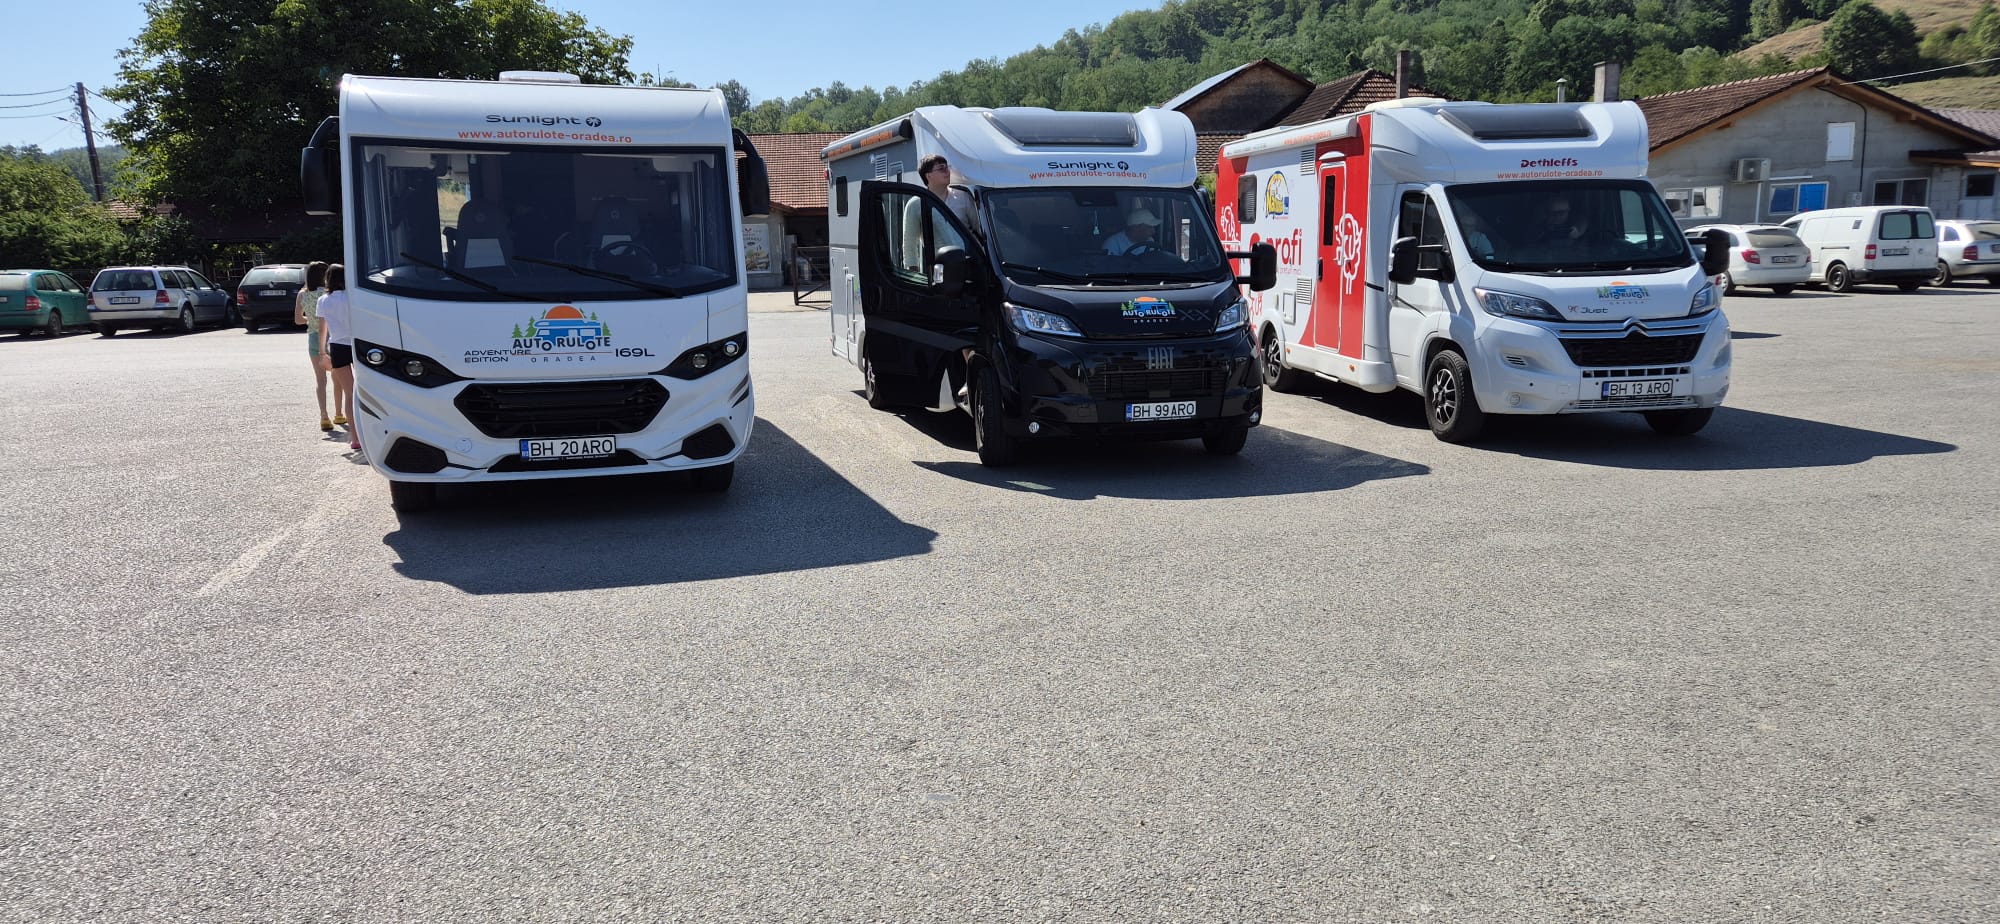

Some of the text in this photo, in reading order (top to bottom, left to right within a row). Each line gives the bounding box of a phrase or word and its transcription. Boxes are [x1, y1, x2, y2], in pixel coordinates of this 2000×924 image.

[486, 114, 582, 126] Sunlight
[458, 130, 632, 144] www.autorulote-oradea.ro
[1047, 161, 1115, 171] Sunlight
[1520, 158, 1578, 168] Dethleffs
[1029, 170, 1147, 180] www.autorulote-oradea.ro
[1497, 168, 1603, 179] www.autorulote-oradea.ro
[1581, 306, 1608, 314] Just
[464, 348, 531, 356] ADVENTURE
[464, 356, 509, 364] EDITION
[530, 355, 596, 363] ORADEA
[1148, 346, 1175, 370] FIAT
[1610, 381, 1671, 396] BH 13 ARO
